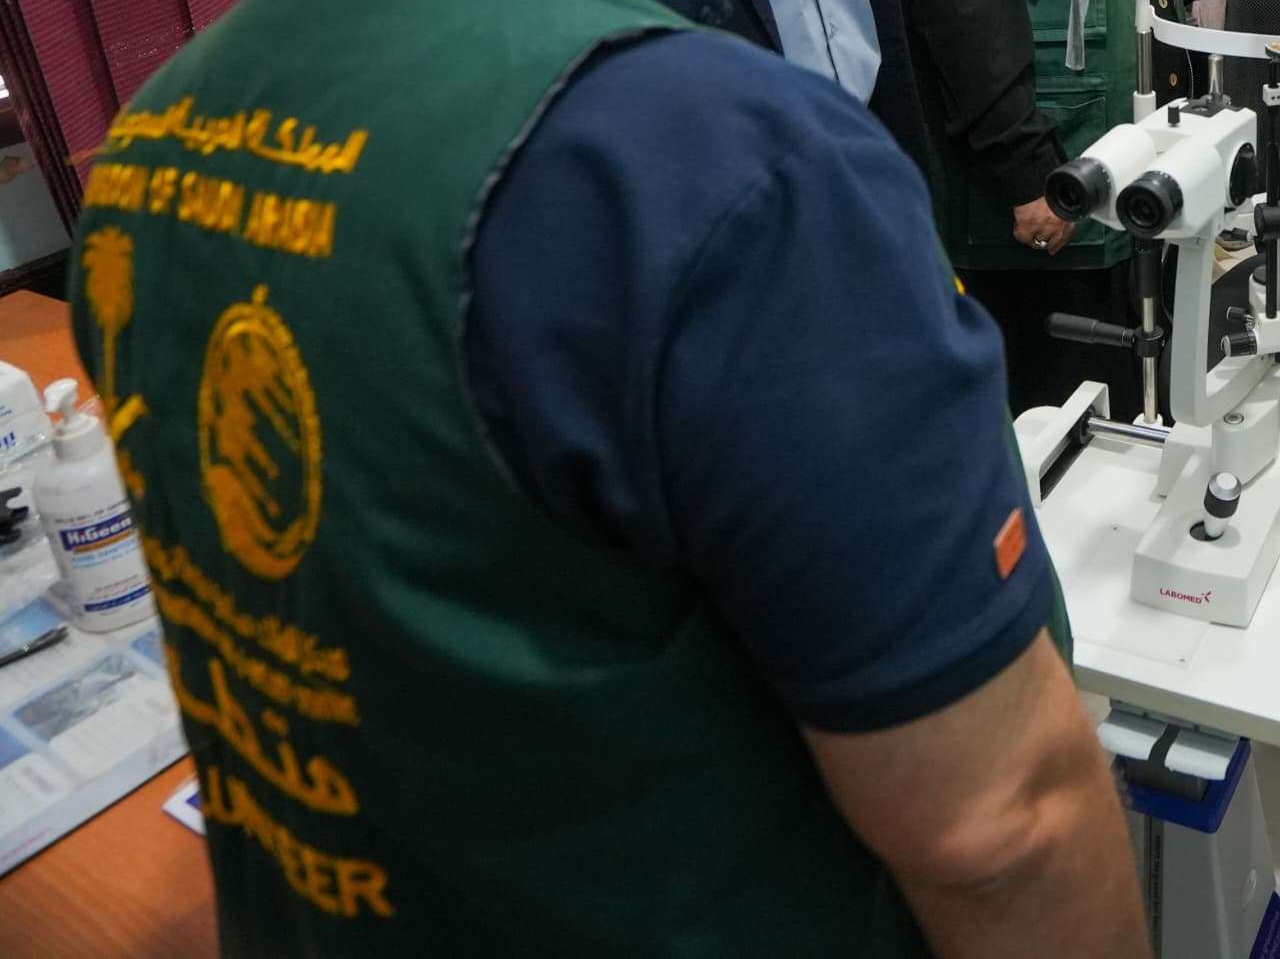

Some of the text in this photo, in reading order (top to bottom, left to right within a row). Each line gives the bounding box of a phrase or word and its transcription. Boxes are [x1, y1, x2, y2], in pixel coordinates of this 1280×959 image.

[246, 108, 368, 174] المملكة
[150, 165, 179, 216] OF
[177, 170, 245, 238] SAUDI
[243, 191, 337, 259] ARABIA
[1159, 587, 1202, 604] LABOMED
